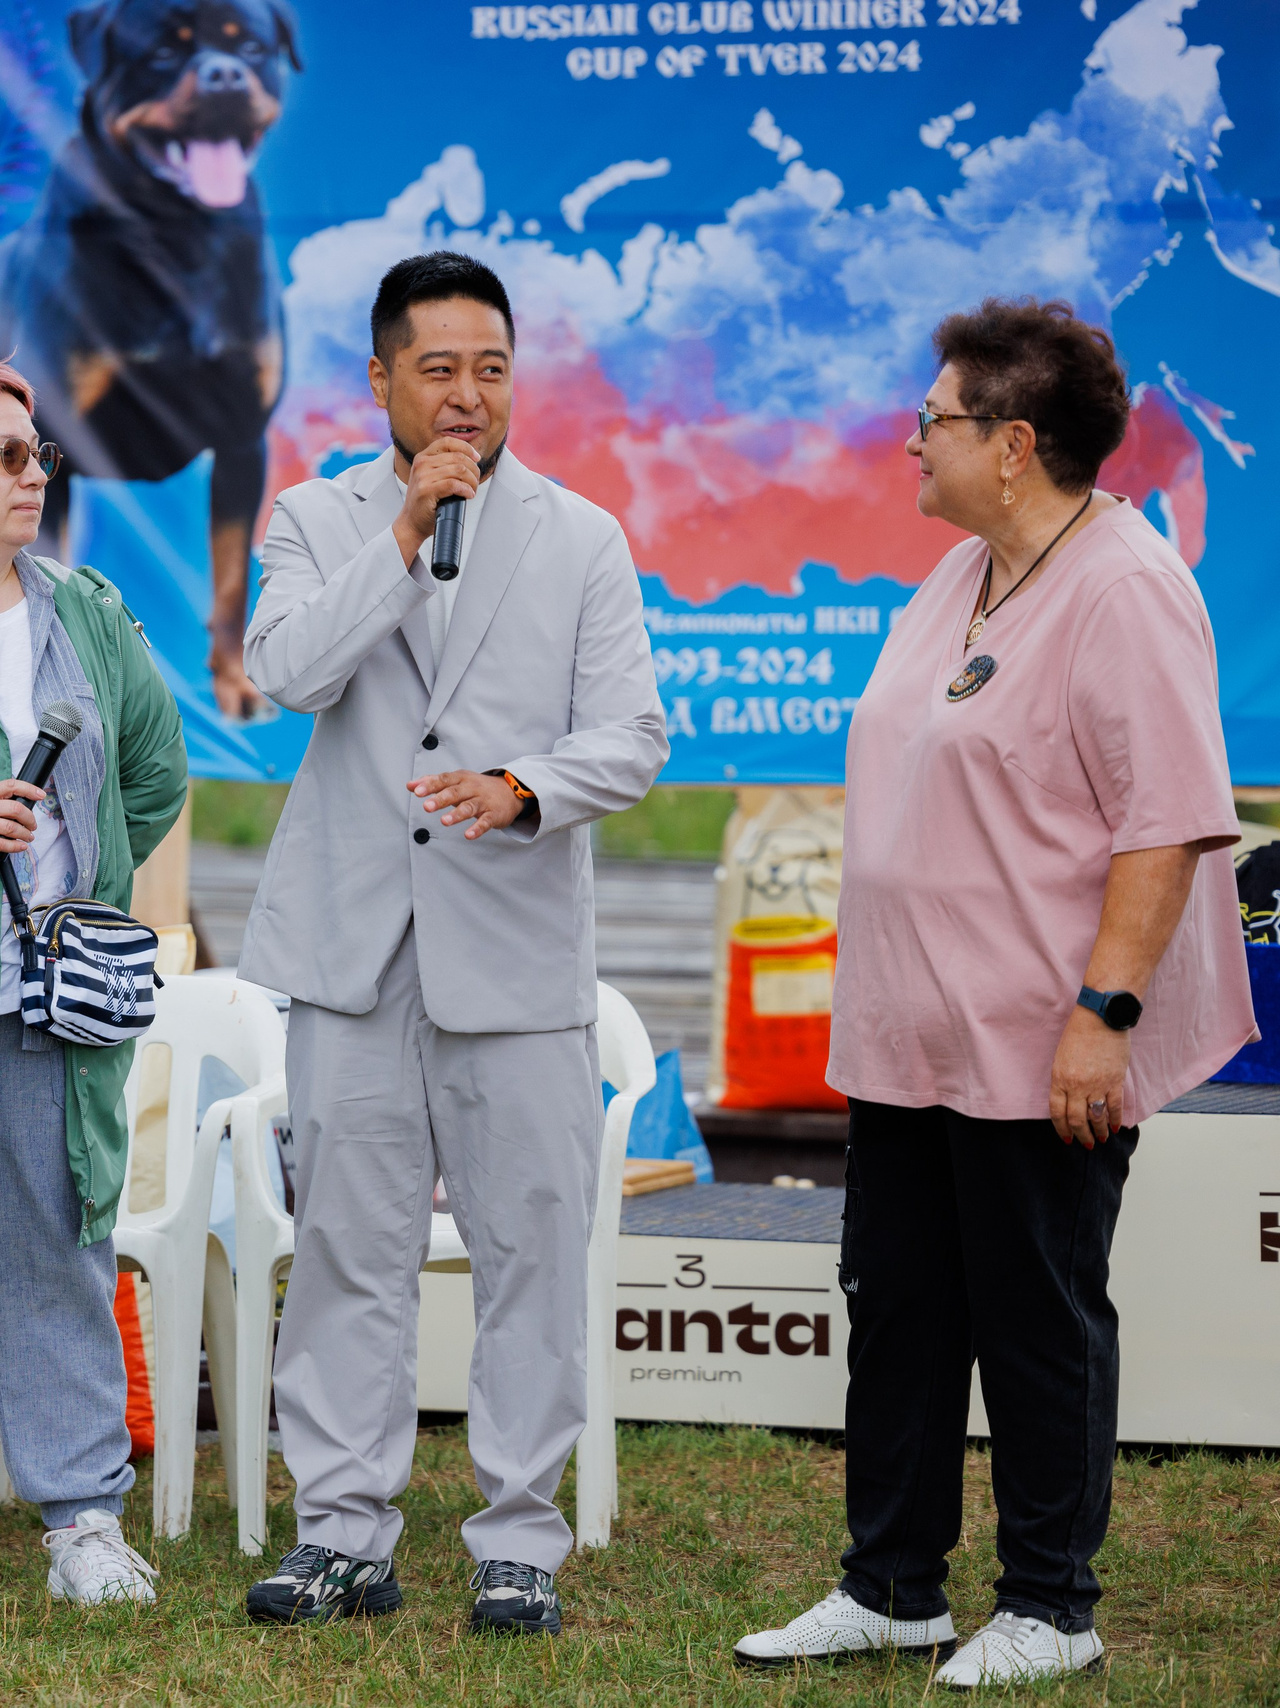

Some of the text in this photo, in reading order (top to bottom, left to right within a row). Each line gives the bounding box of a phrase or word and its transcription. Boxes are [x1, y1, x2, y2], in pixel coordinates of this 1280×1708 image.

[471, 0, 1022, 41] RUSSIAN CLUB WINNER 2024
[566, 39, 923, 81] CUP OF TVER 2024
[653, 646, 836, 686] 993-2024
[674, 1254, 707, 1289] 3
[615, 1301, 831, 1357] anta
[629, 1365, 743, 1383] premium
